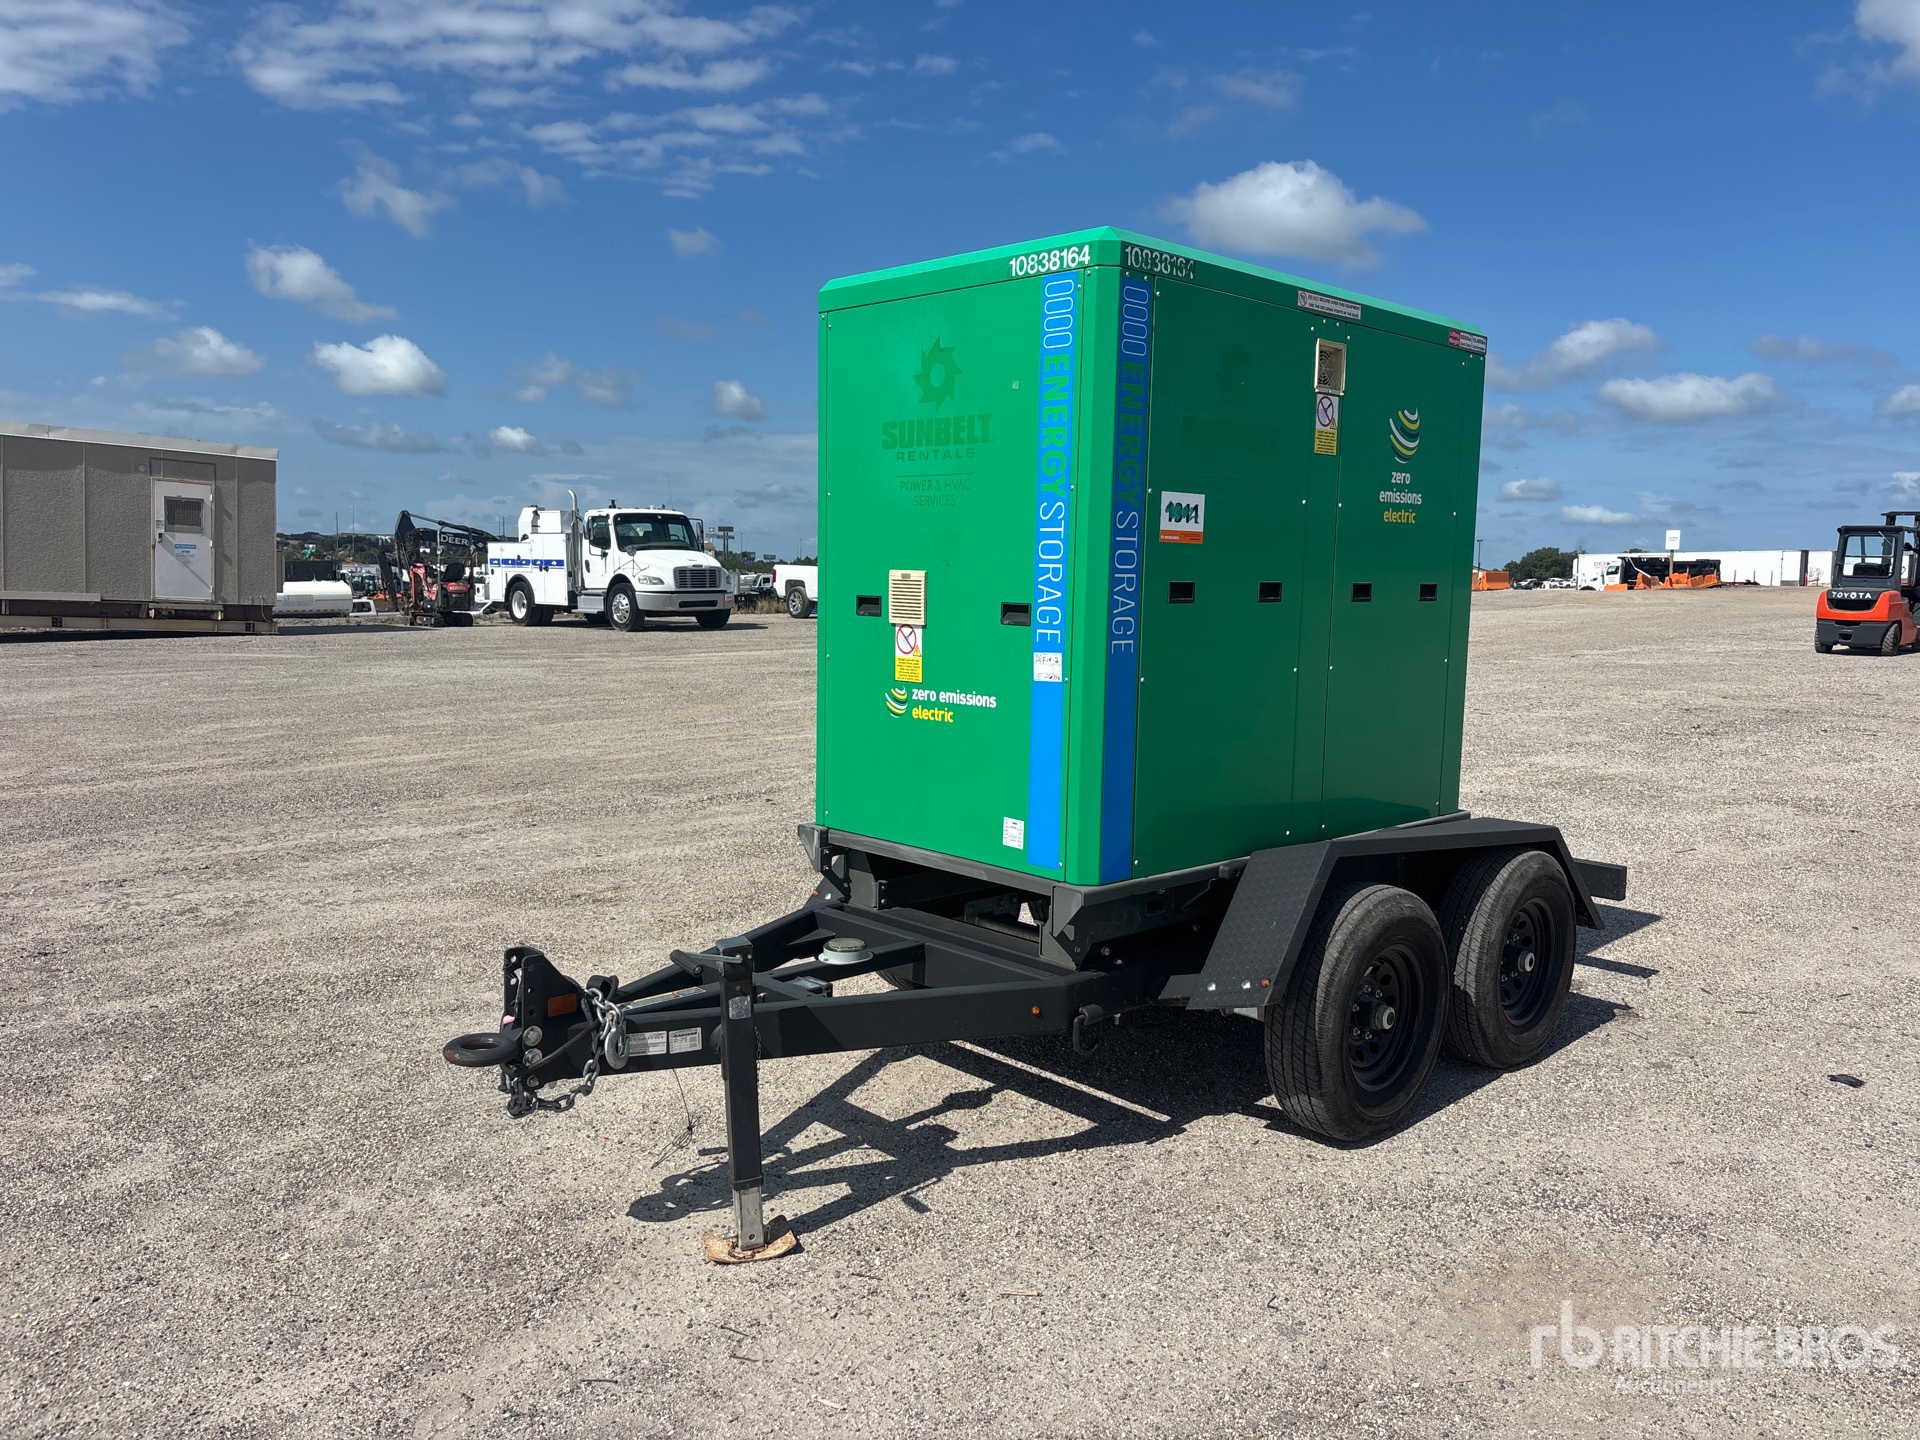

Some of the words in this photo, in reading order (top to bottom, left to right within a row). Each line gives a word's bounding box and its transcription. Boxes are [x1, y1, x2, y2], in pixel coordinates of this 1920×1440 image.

[1009, 244, 1091, 277] 10838164
[881, 413, 993, 450] SUNBELT
[1040, 353, 1070, 498] ENERGY
[1117, 360, 1145, 508] ENERGY
[896, 447, 976, 462] RENTALS
[900, 480, 933, 492] POWER
[934, 480, 943, 491] &
[944, 478, 971, 491] HVAC
[1391, 471, 1411, 485] zero
[913, 494, 957, 507] SERVICES
[1379, 488, 1422, 505] emissions
[1383, 508, 1416, 524] electric
[440, 534, 474, 546] DEER
[1036, 501, 1065, 644] STORAGE
[1111, 510, 1139, 655] STORAGE
[1831, 591, 1872, 600] TOYOTA
[912, 688, 936, 702] zero
[939, 690, 997, 709] emissions
[912, 705, 954, 723] electric
